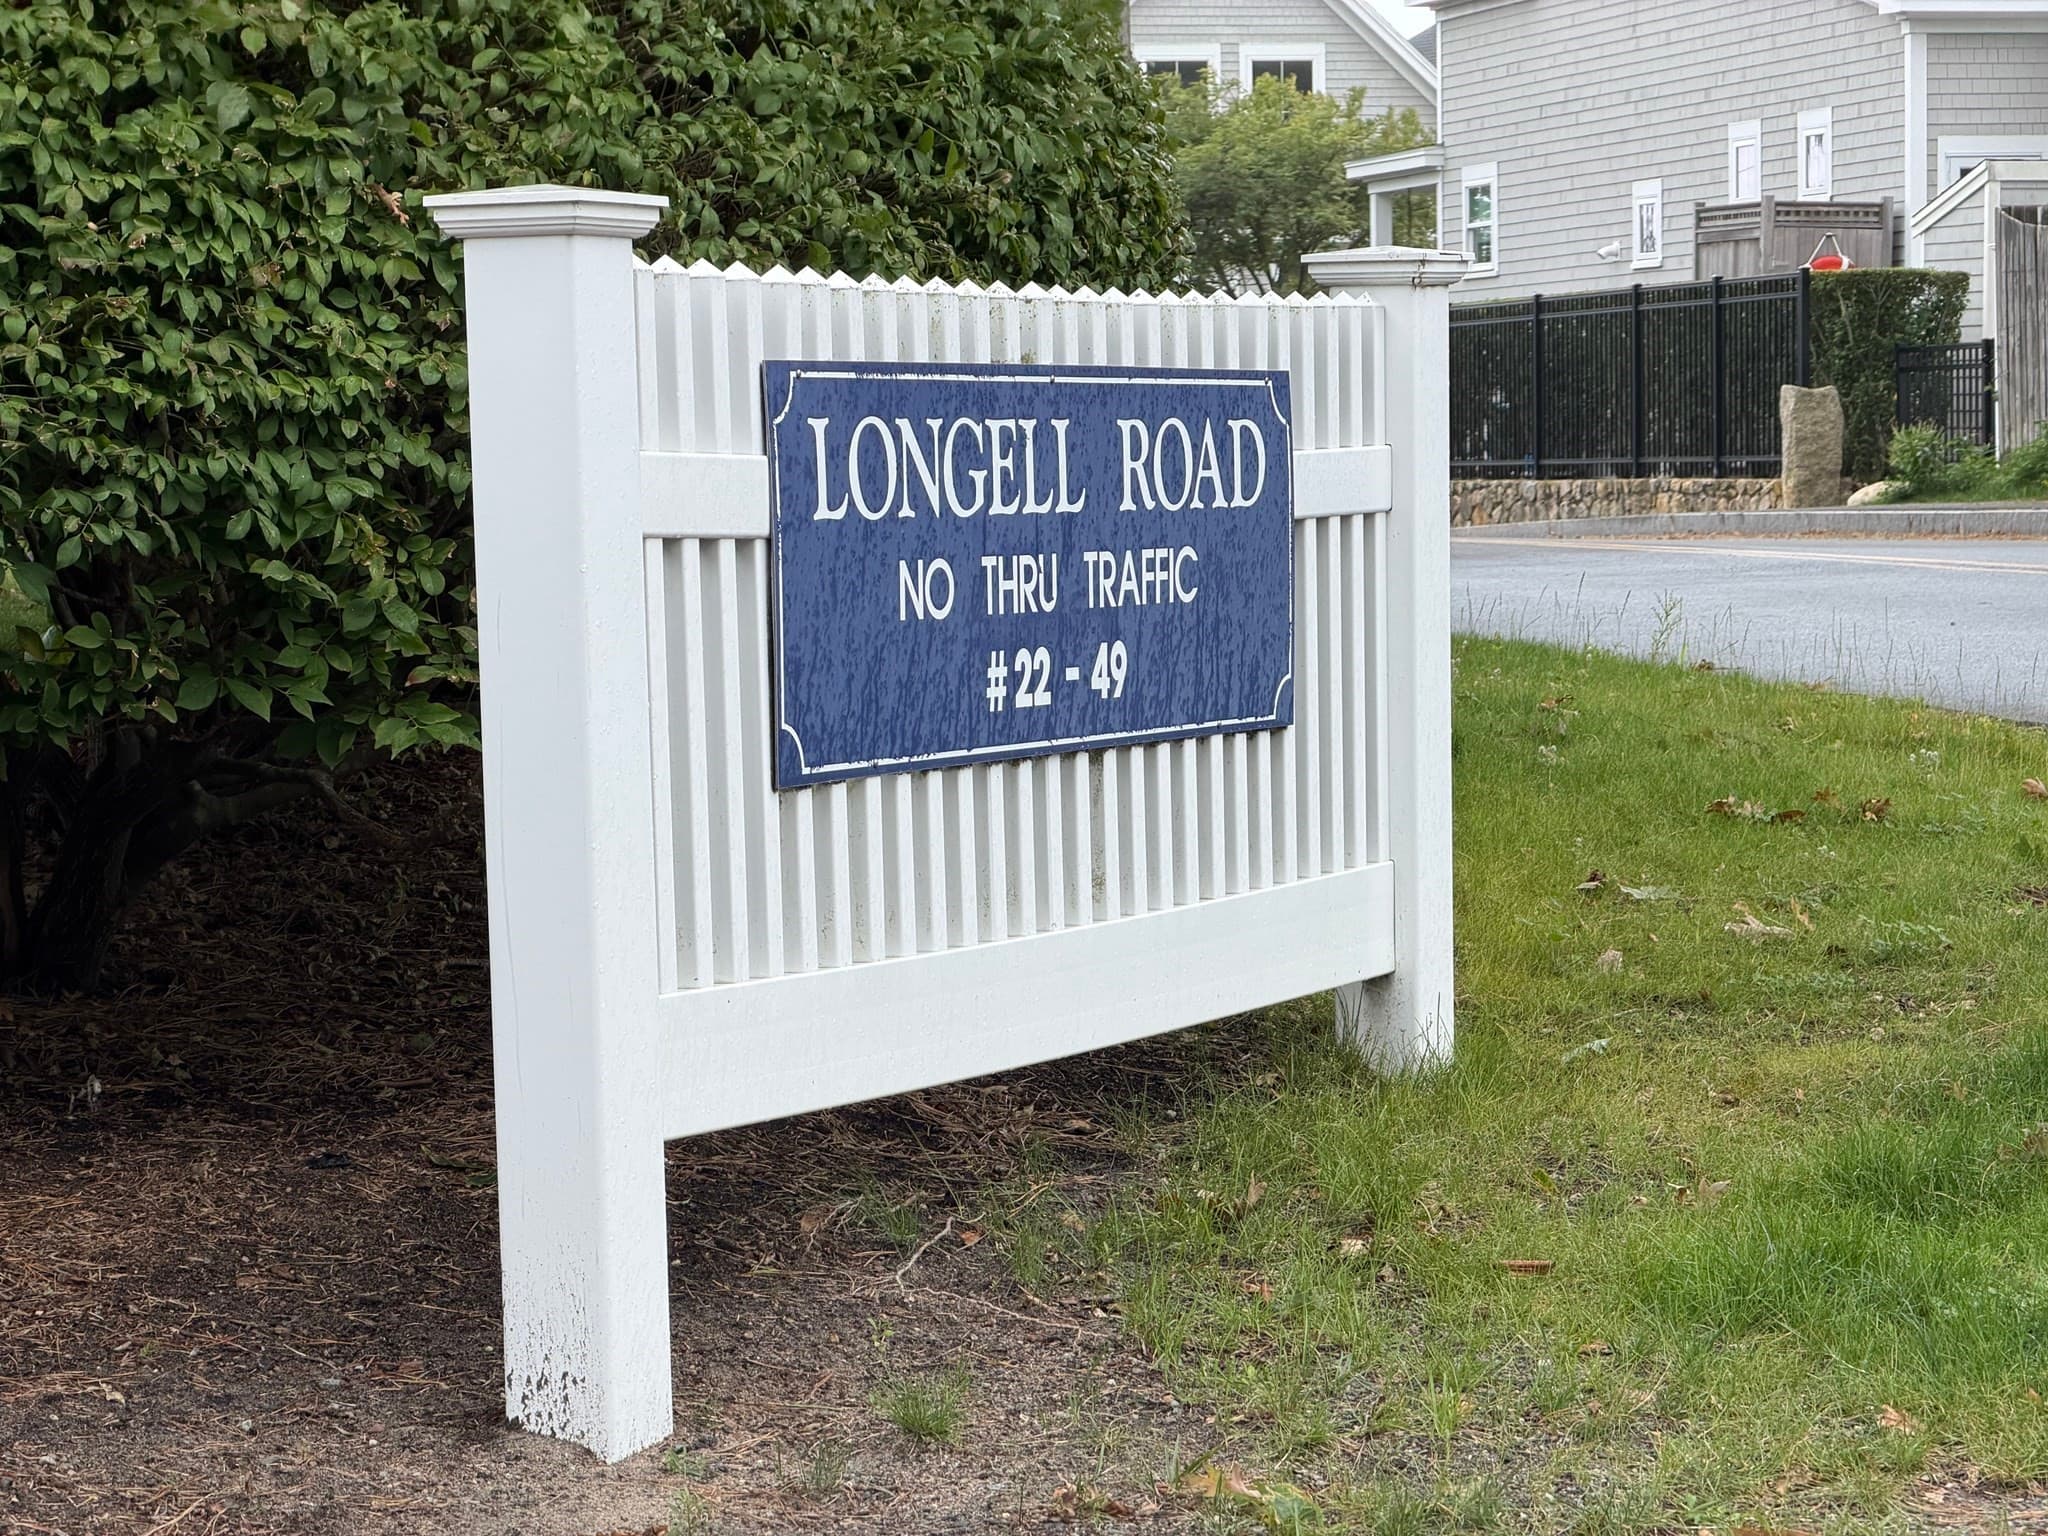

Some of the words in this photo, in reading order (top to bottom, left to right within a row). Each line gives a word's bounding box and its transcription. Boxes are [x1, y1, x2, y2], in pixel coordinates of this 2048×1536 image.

[807, 416, 1086, 520] LONGELL
[1117, 417, 1266, 511] ROAD
[899, 557, 955, 620] NO
[981, 553, 1058, 615] THRU
[1083, 545, 1199, 608] TRAFFIC
[1090, 639, 1128, 699] 49
